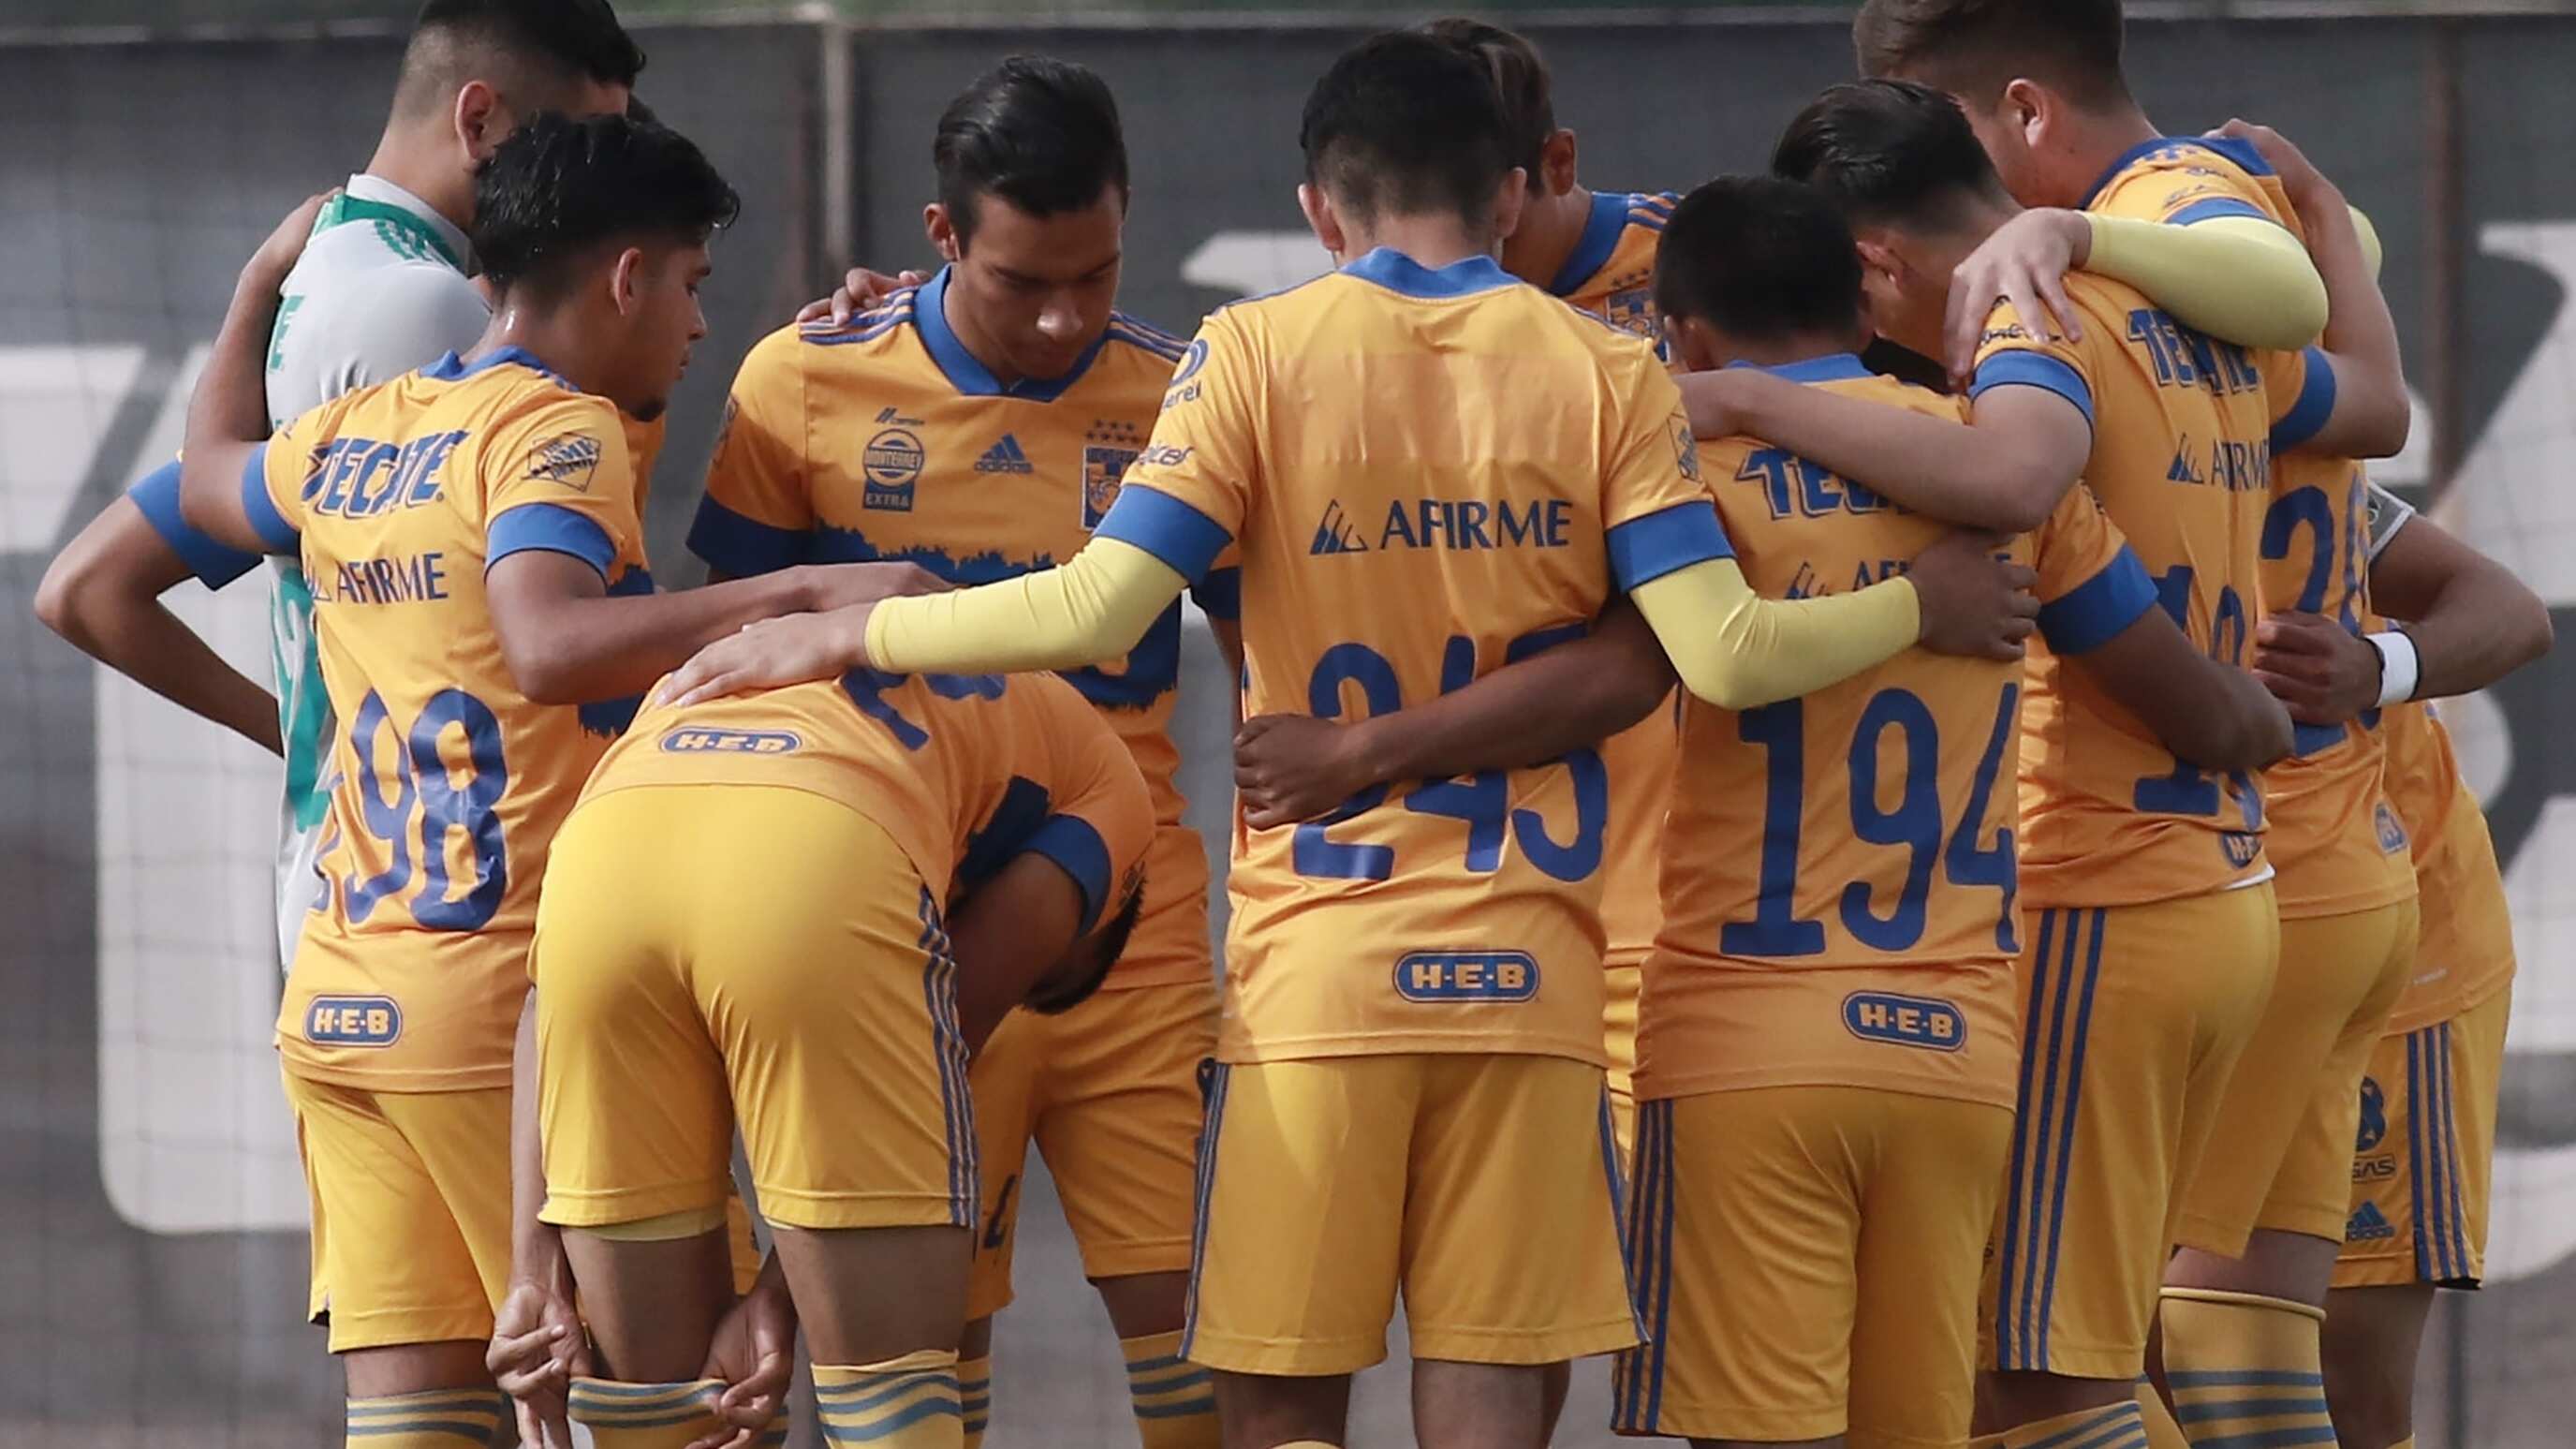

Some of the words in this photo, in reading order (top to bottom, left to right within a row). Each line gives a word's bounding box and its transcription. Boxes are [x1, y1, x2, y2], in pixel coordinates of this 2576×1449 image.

[974, 459, 1035, 475] adidas
[865, 492, 911, 510] EXTRA
[1379, 499, 1573, 550] AFIRME
[335, 551, 449, 604] AFIRME
[1720, 682, 2021, 956] 194
[2347, 1226, 2395, 1242] didas
